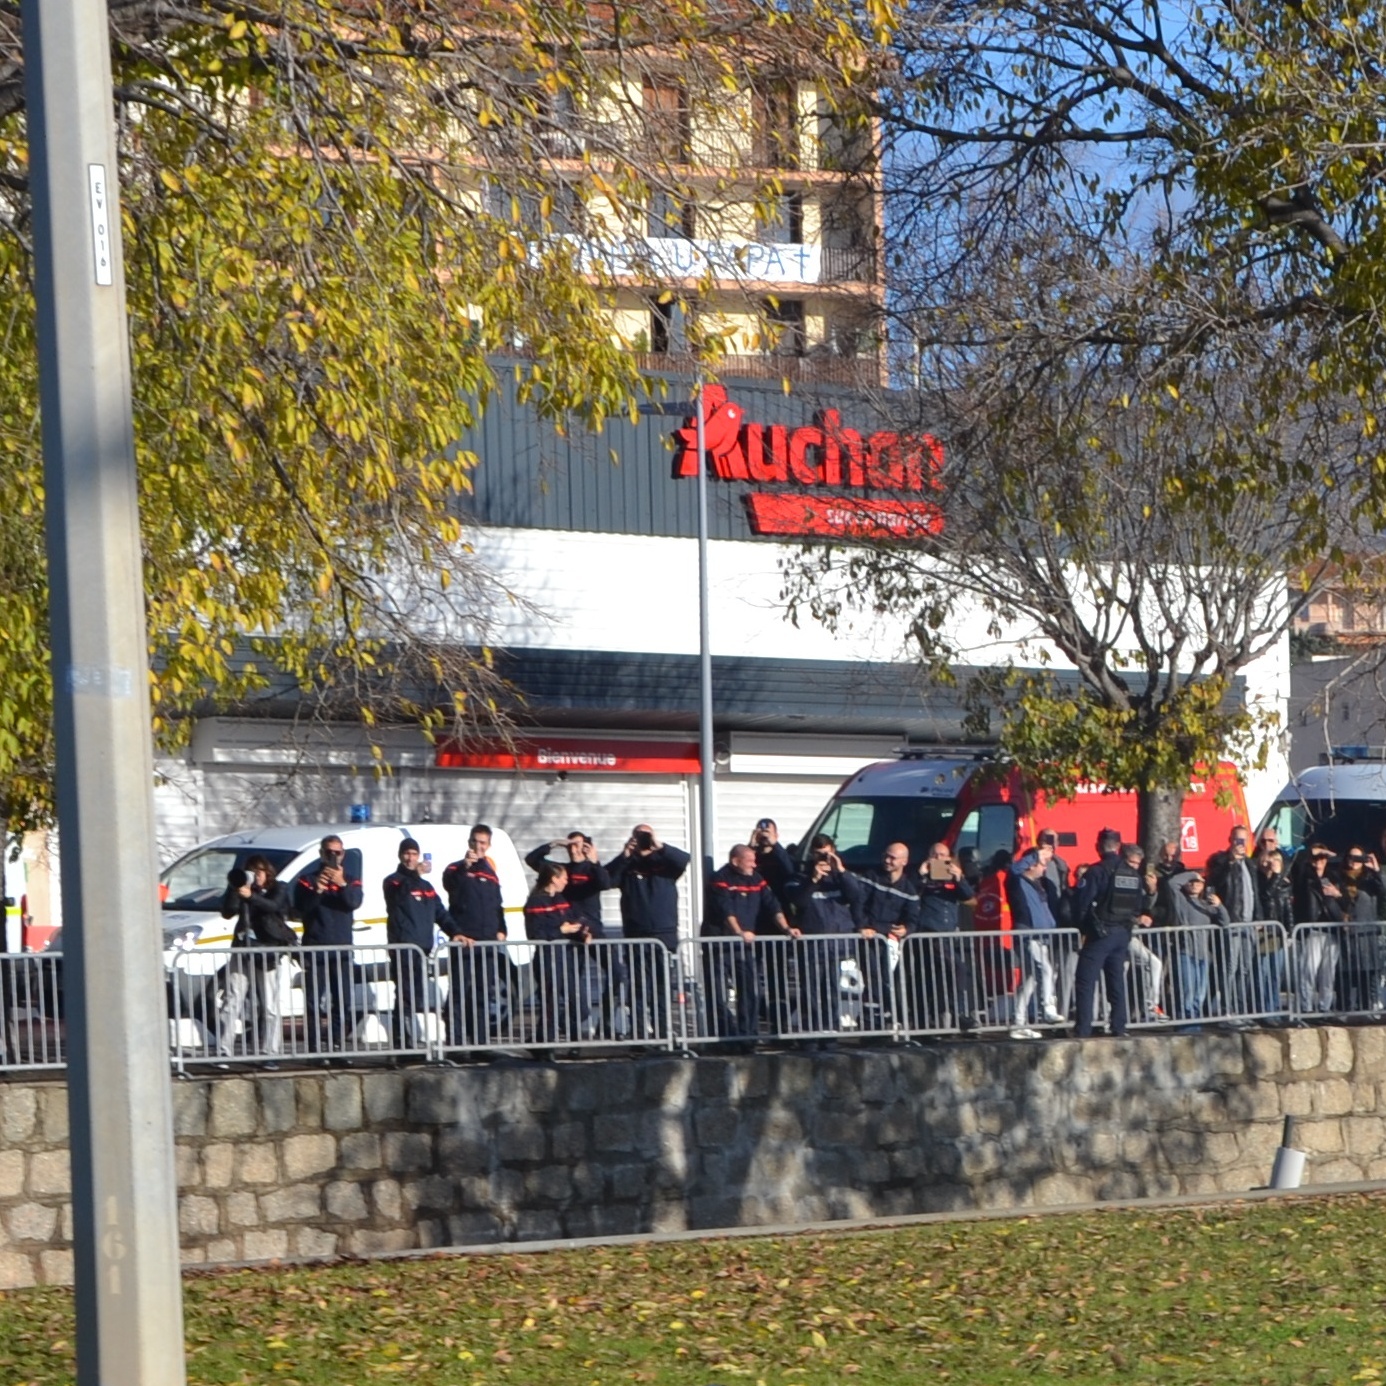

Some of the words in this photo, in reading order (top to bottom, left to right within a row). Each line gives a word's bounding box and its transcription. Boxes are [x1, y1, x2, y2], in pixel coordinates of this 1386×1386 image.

[94, 181, 103, 209] EV
[676, 383, 946, 492] Auchan
[537, 746, 616, 766] Bienvenue
